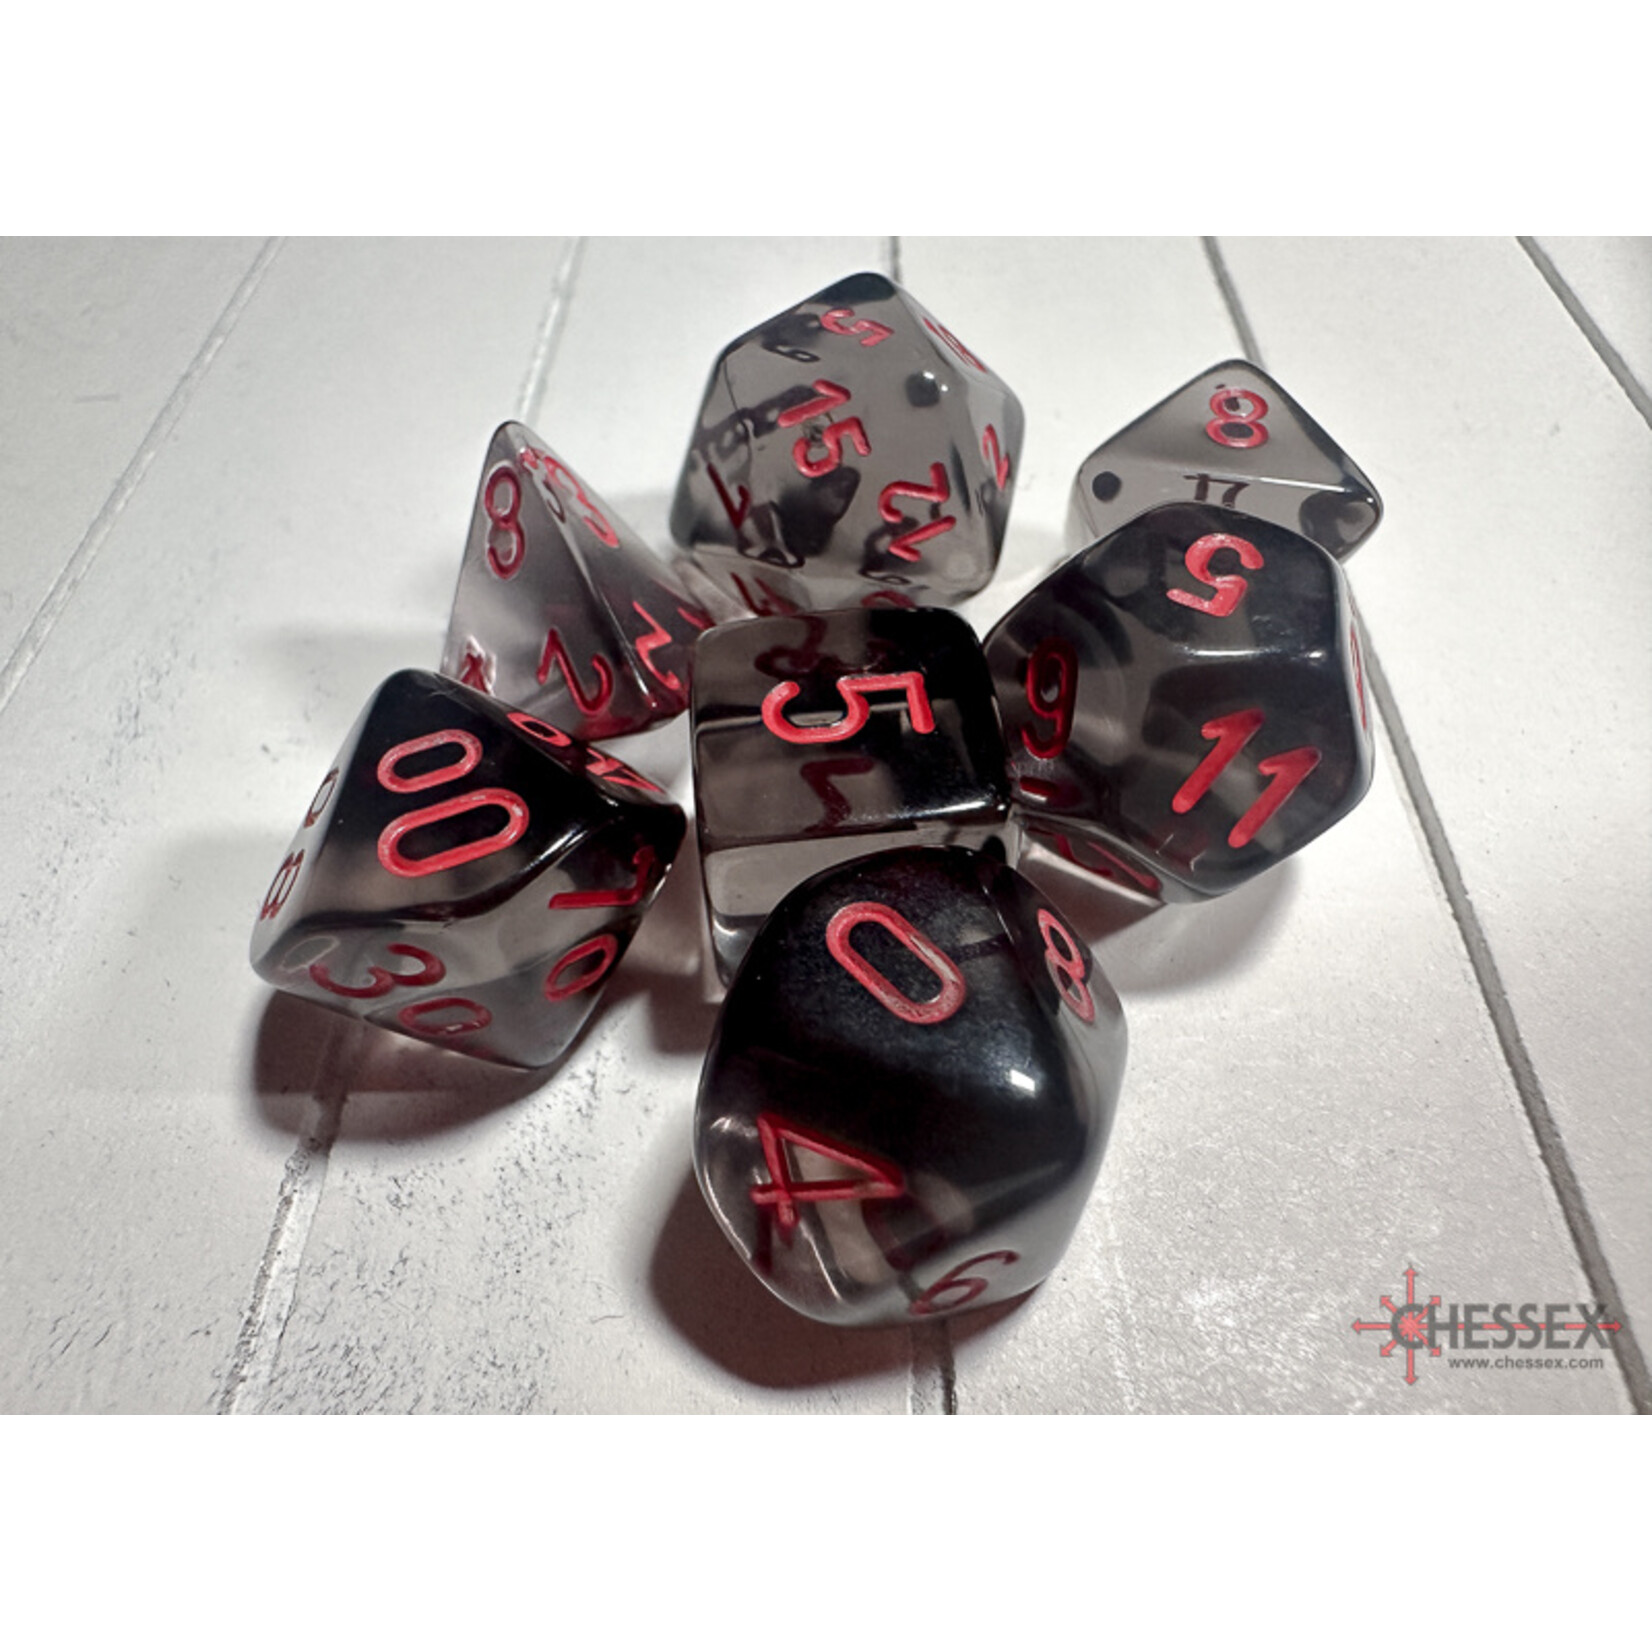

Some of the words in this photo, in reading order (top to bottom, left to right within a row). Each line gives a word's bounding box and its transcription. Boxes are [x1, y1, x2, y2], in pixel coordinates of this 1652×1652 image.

[820, 308, 894, 347] 5
[777, 378, 872, 478] 15
[1205, 387, 1269, 449] 8
[1166, 532, 1264, 617] 5
[760, 670, 937, 745] 5
[377, 728, 530, 878] 00
[1172, 707, 1323, 849] 11
[825, 900, 967, 1025] 0
[1037, 907, 1096, 1025] 8
[749, 1111, 905, 1233] 4
